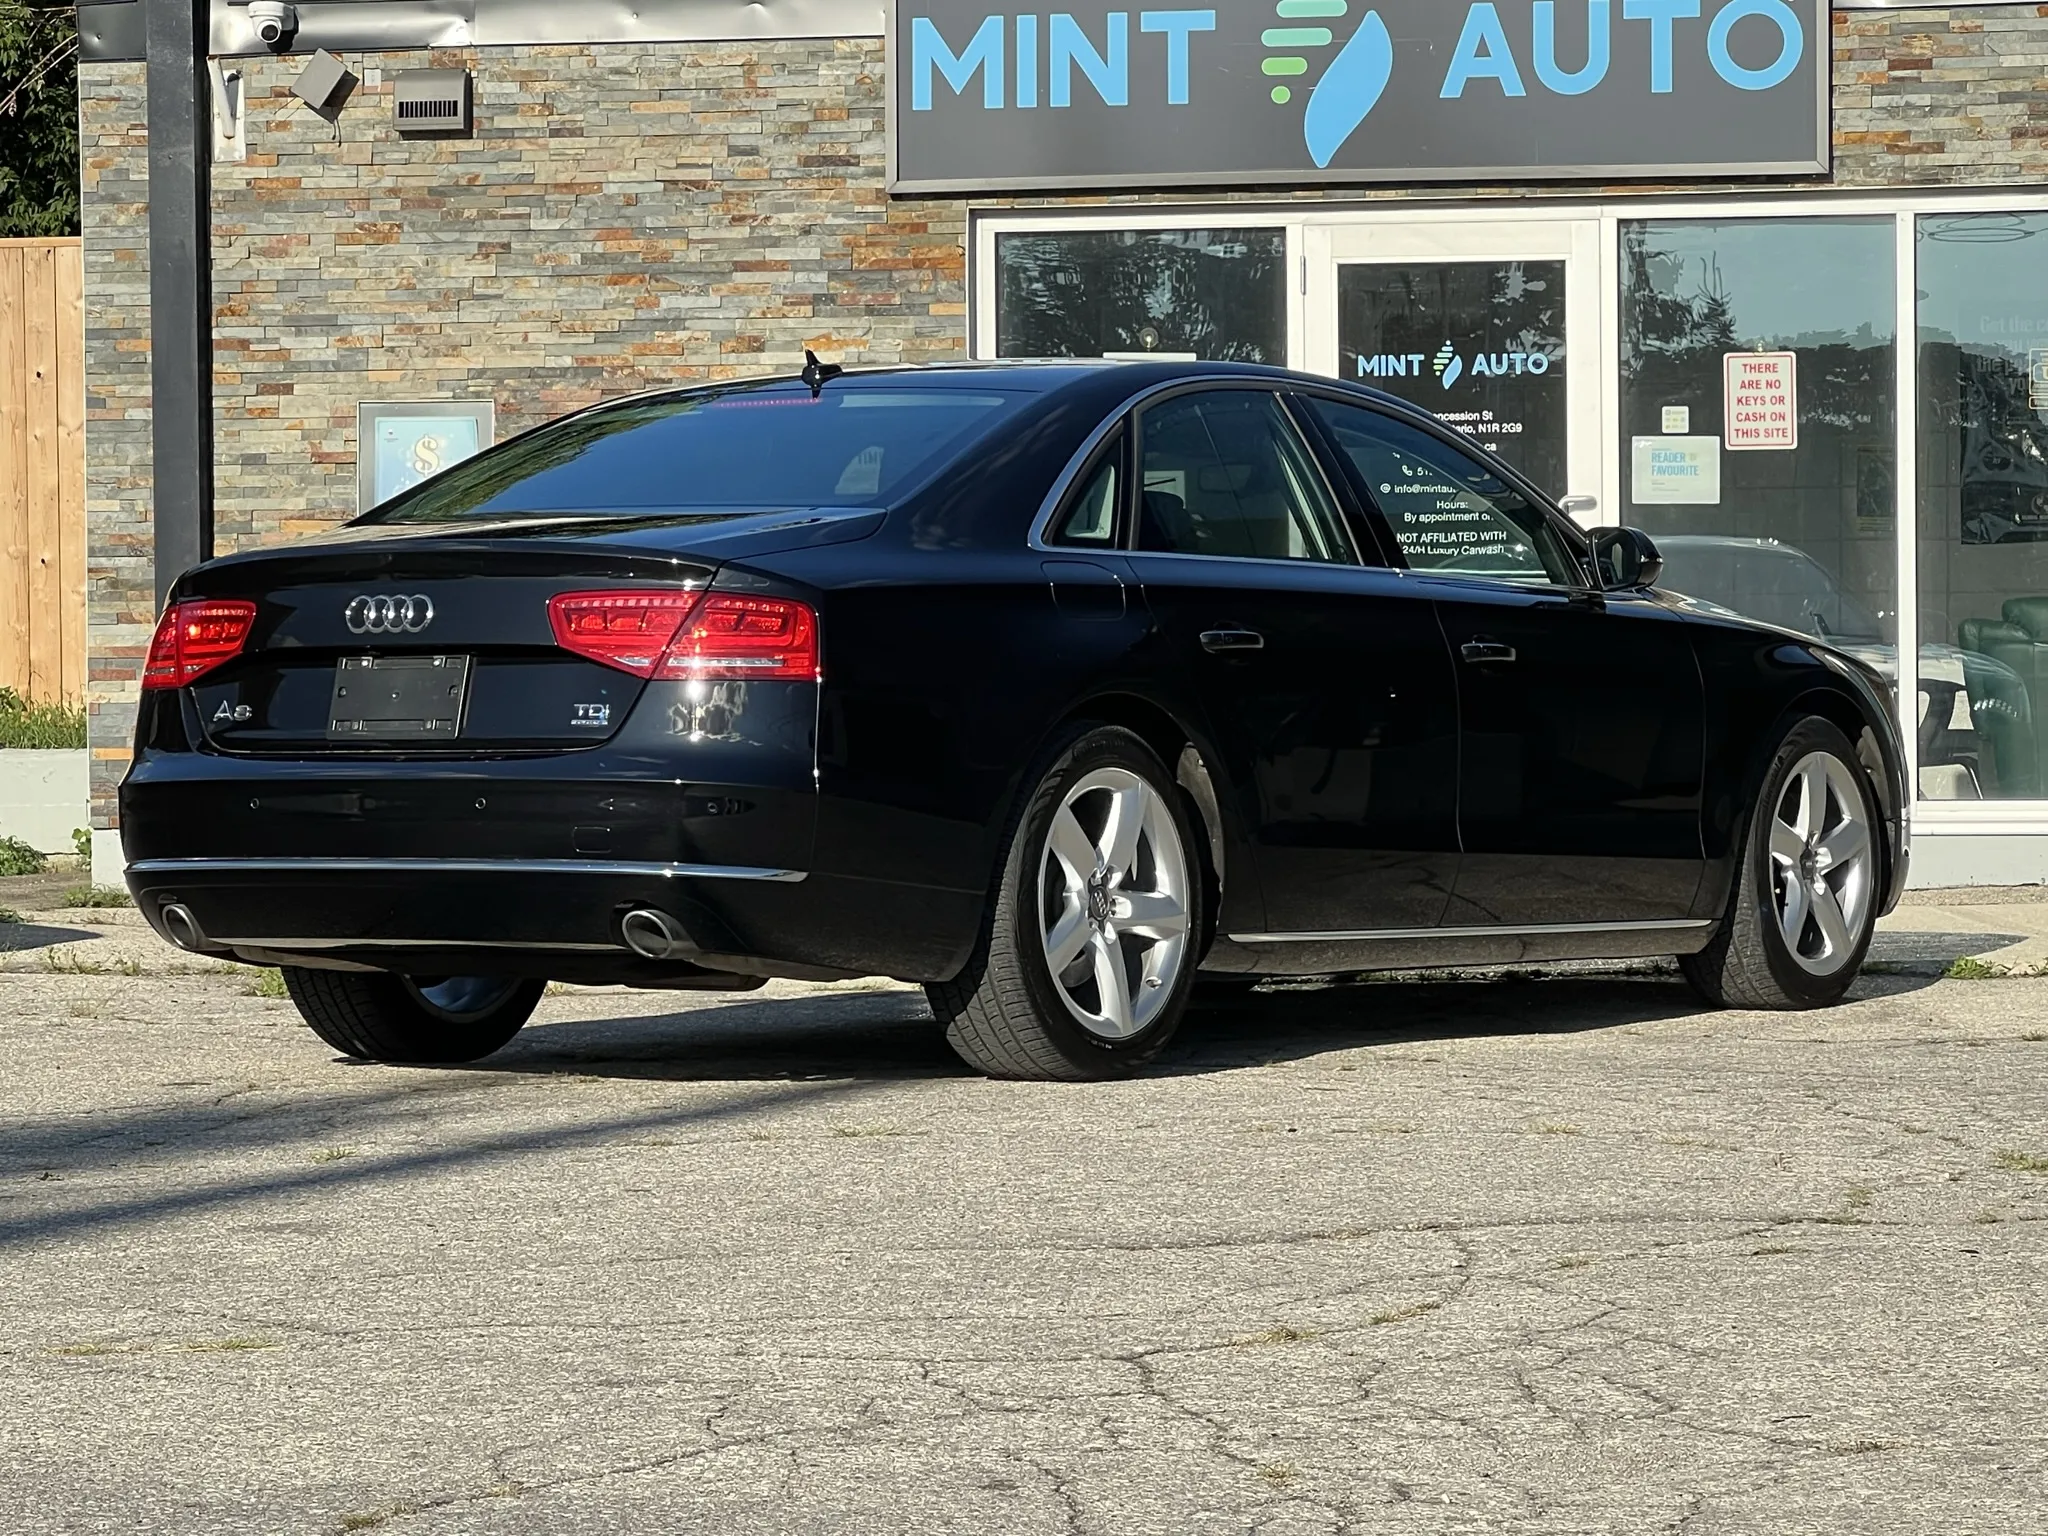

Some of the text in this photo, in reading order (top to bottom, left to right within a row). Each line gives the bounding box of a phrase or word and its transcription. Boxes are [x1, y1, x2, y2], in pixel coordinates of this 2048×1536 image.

[911, 0, 1804, 111] MINT AUTO
[1357, 352, 1549, 377] MINT AUTO
[1742, 363, 1779, 374] THERE
[1739, 379, 1782, 390] ARE NO
[1736, 395, 1786, 406] KEYS OR
[1482, 410, 1493, 421] St
[1736, 411, 1786, 422] CASH ON
[1478, 423, 1500, 434] N1R
[1502, 423, 1523, 433] 2G9
[1734, 427, 1789, 439] THIS SITE
[1651, 452, 1686, 464] READER
[1651, 464, 1699, 477] FAVOURITE
[1437, 500, 1469, 509] Hours:
[1404, 512, 1417, 524] By
[1419, 512, 1479, 523] appointment
[1397, 531, 1507, 543] NOT AFFILIATED WITH
[1427, 546, 1459, 556] Luxury
[1461, 544, 1505, 555] Carwash
[573, 703, 610, 719] TDI
